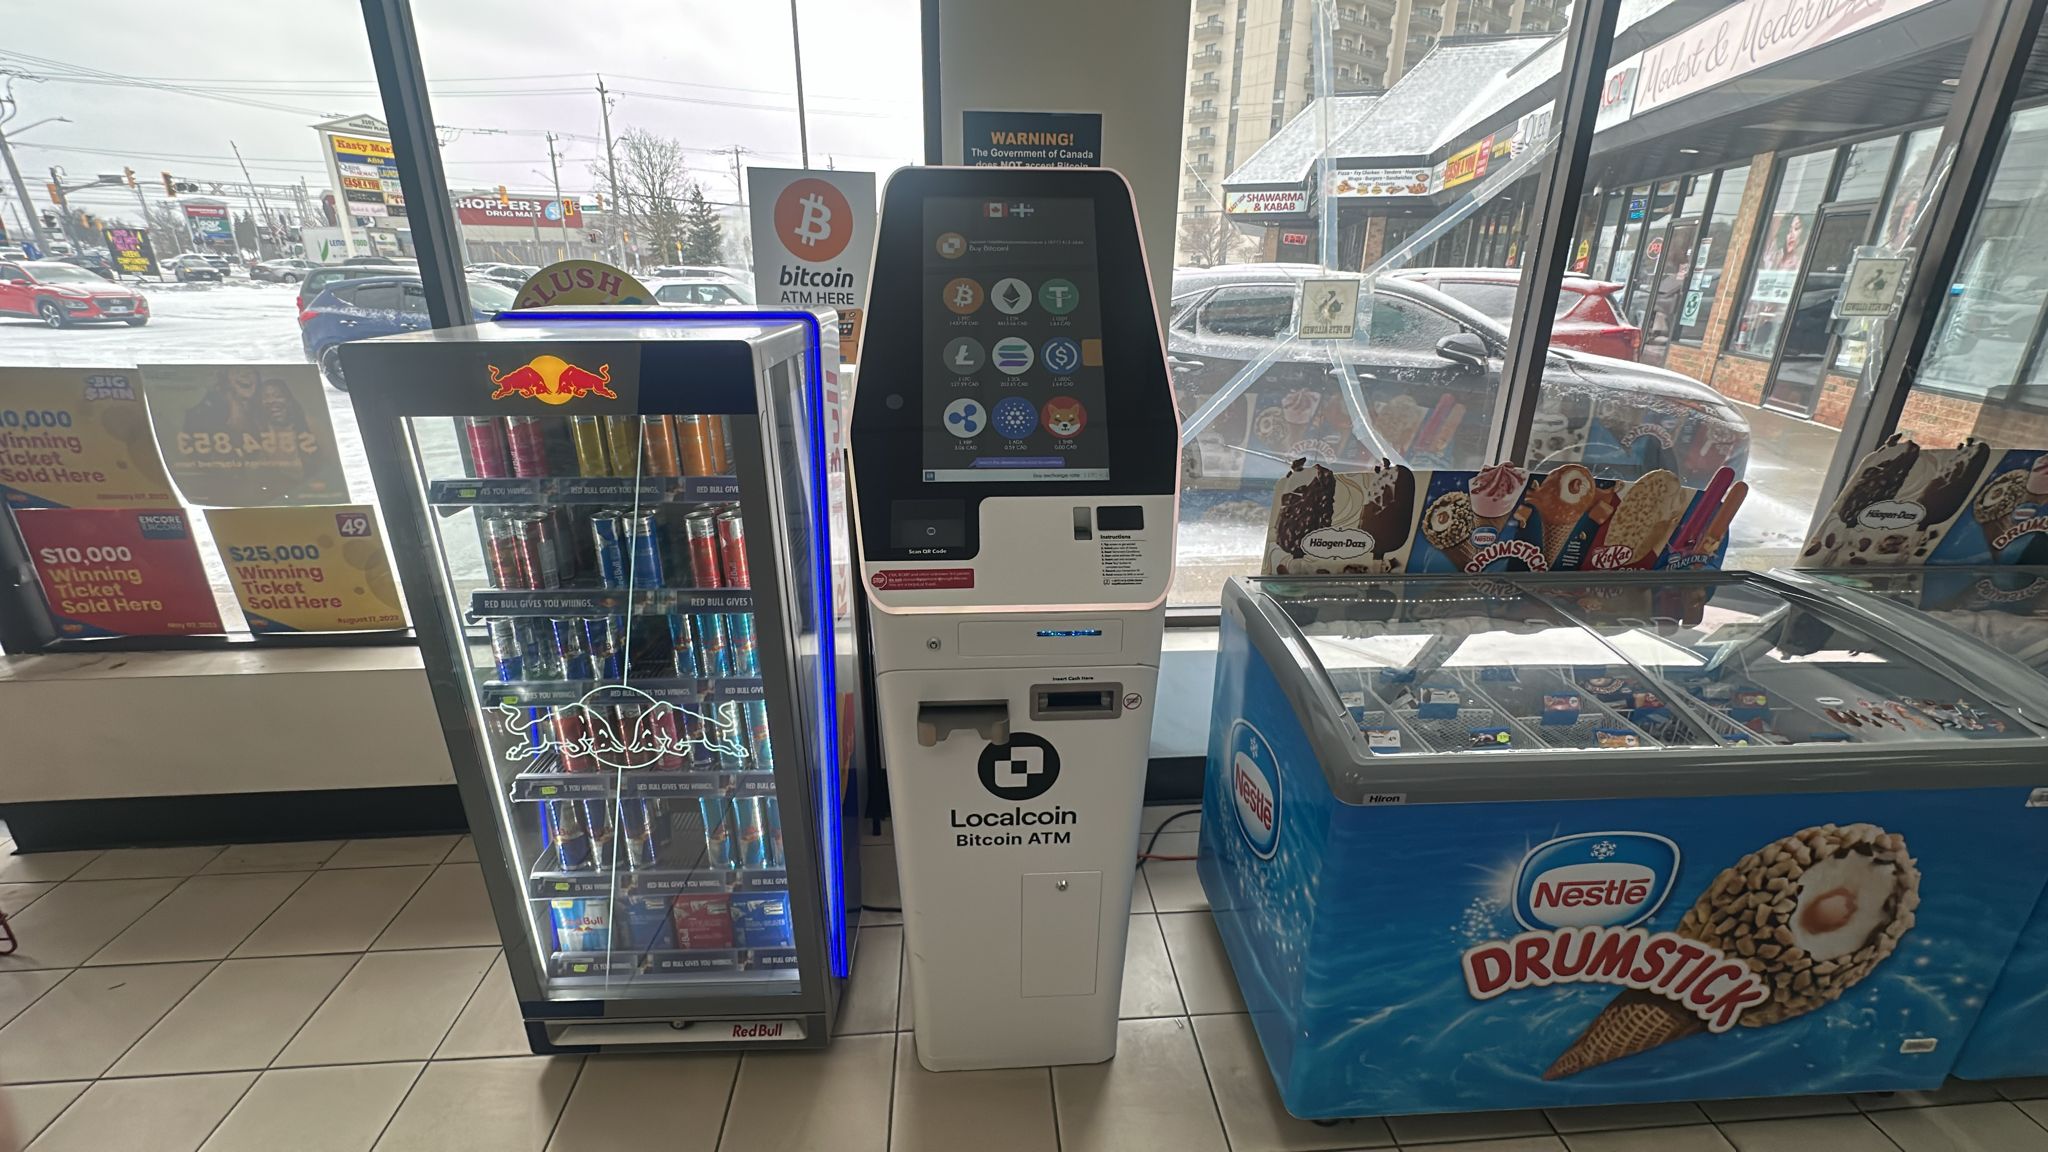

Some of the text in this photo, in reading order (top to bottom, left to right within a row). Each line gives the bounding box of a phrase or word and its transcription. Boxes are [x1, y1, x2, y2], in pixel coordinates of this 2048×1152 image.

[1639, 38, 1703, 107] Modest
[991, 131, 1074, 146] WARNING!
[971, 147, 1093, 159] The Government of Canada
[1246, 192, 1304, 202] SHAWARMA
[486, 209, 510, 218] DRUG
[1253, 202, 1295, 211] & KABAB
[329, 239, 346, 247] LEMO
[779, 264, 854, 288] bitcoin
[780, 290, 855, 305] ATM HERE
[93, 376, 126, 388] BIG
[84, 387, 135, 401] SPIN
[1, 467, 107, 483] Sold Here
[138, 515, 182, 524] ENCORE
[341, 518, 367, 535] 49
[39, 546, 132, 566] $10,000
[229, 544, 320, 564] $25,000
[1465, 540, 1550, 573] DRUMSTICK
[1592, 547, 1633, 568] KitKat
[49, 565, 143, 585] Winning
[236, 563, 324, 583] Winning
[53, 583, 124, 599] Ticket
[241, 580, 305, 595] Ticket
[61, 597, 163, 615] Sold Here
[249, 595, 343, 611] Sold Here
[484, 599, 499, 609] RED
[500, 599, 519, 609] BULL
[520, 599, 541, 608] GIVES
[543, 599, 559, 608] YOU
[691, 597, 706, 606] RED
[707, 597, 724, 606] BULL
[726, 597, 748, 606] GIVES
[337, 616, 368, 625] August
[725, 687, 750, 695] RED BULL
[1369, 795, 1401, 803] Hiron
[951, 806, 1077, 828] Localcoin
[956, 831, 1071, 847] Bitcoin ATM
[1533, 878, 1650, 909] Nestlé
[583, 917, 603, 926] Bull
[1470, 931, 1762, 1027] DRUMSTICK
[732, 1023, 783, 1038] Red Bull
